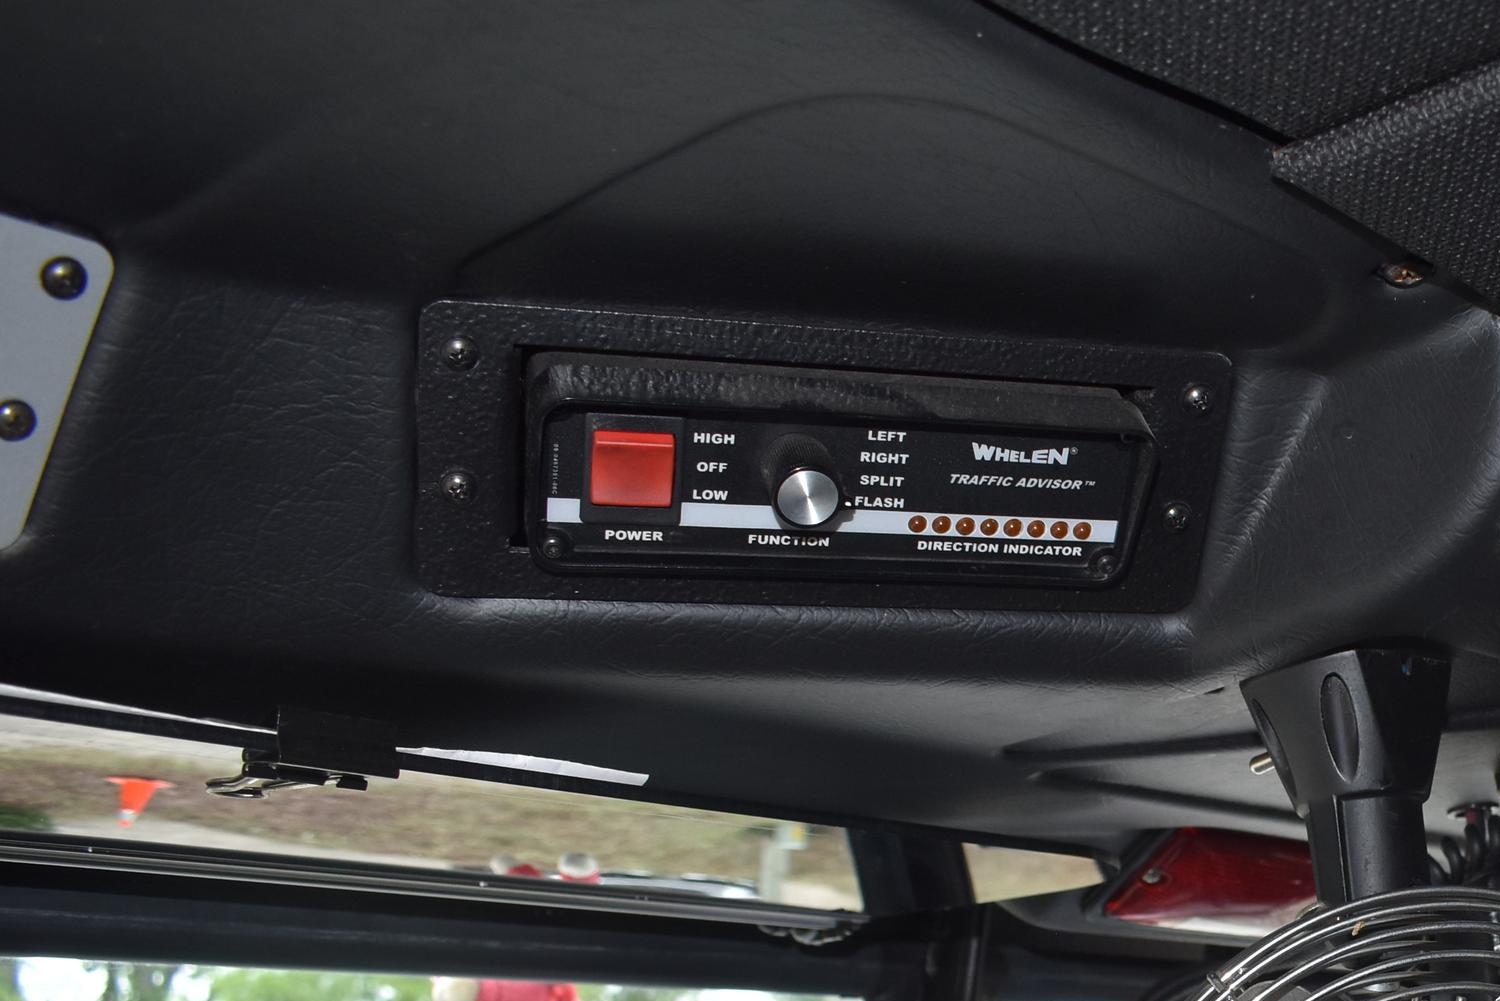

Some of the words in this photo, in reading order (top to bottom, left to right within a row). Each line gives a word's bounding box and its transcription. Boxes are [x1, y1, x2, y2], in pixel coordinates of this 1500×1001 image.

[693, 432, 736, 445] HIGH
[867, 430, 907, 442] LEFT
[860, 452, 910, 465] RIGHT
[696, 462, 728, 473] OFF
[860, 475, 905, 487] SPLIT
[950, 473, 1013, 487] TRAFFIC
[692, 489, 728, 501] LOW
[854, 496, 905, 509] FLASH
[604, 529, 664, 542] POWER
[748, 534, 830, 547] FUNCTION
[917, 541, 999, 554] DIRECTION
[1003, 544, 1082, 557] INDICATOR
